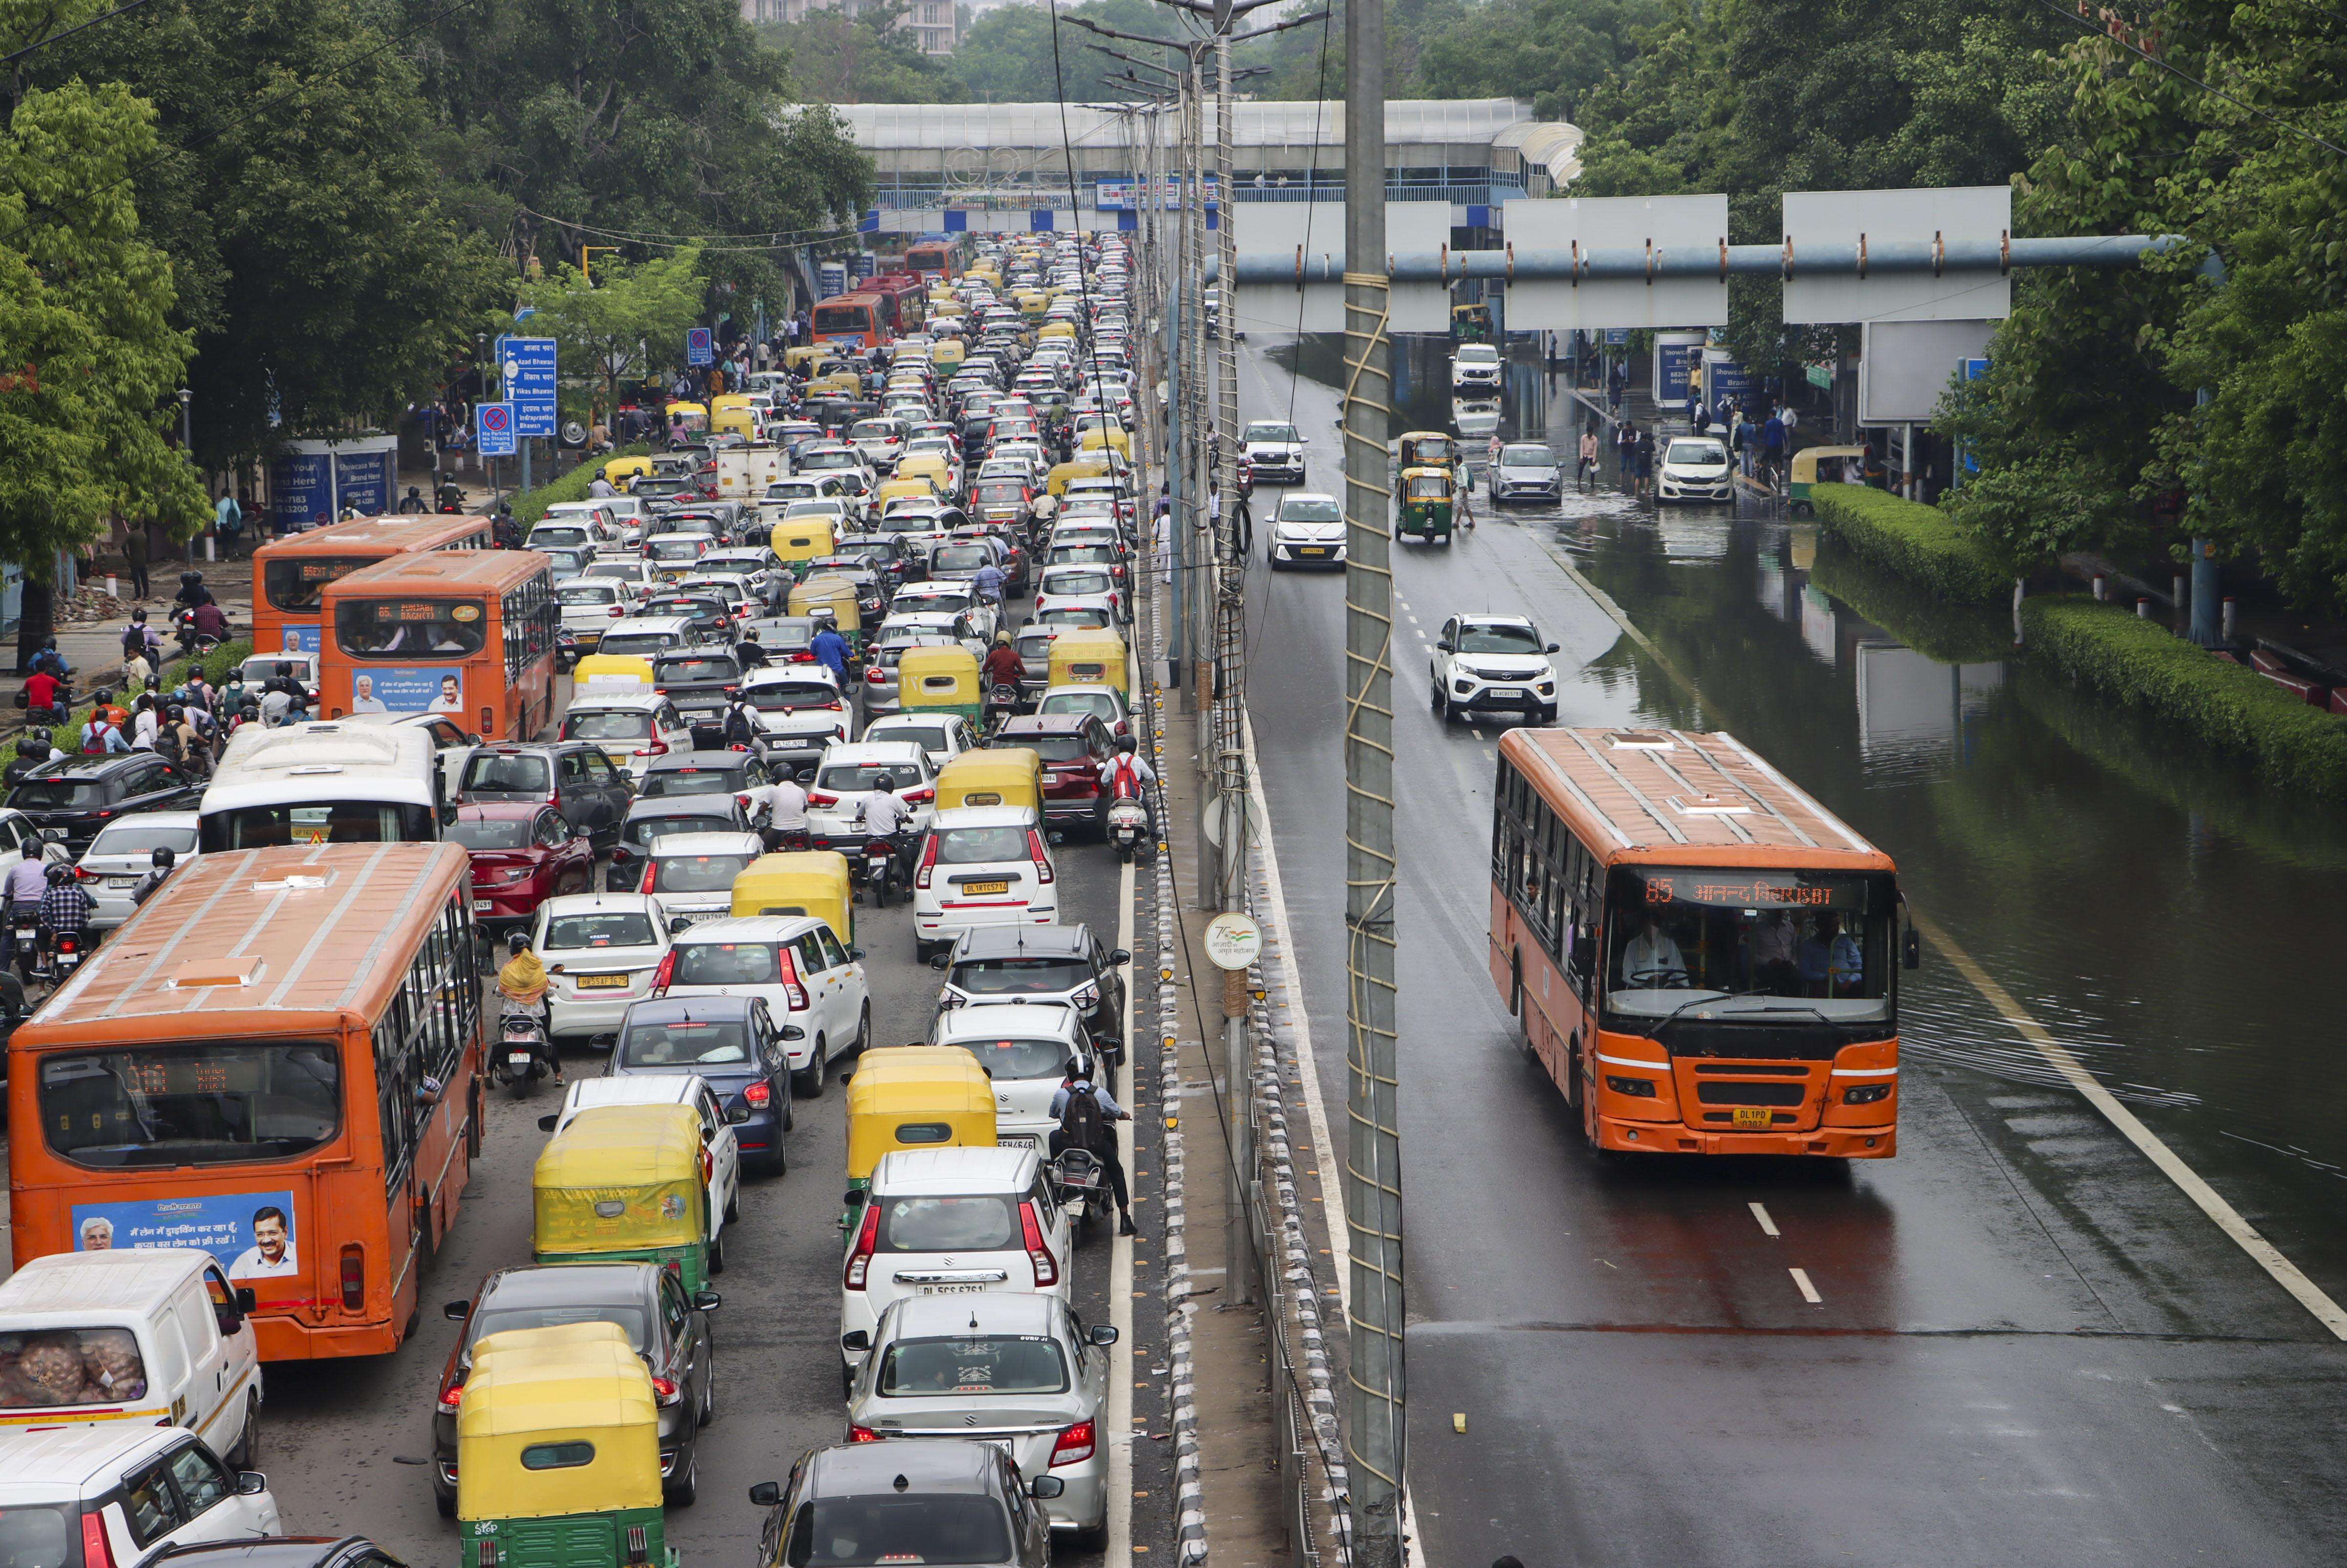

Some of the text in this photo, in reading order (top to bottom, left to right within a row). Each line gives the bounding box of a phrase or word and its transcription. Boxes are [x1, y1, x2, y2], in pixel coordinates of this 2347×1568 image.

[339, 464, 368, 472] Showcase
[967, 883, 1007, 892] DL1RTC5714
[1646, 878, 1673, 903] 85
[1217, 947, 1255, 956] अमृत महोत्सव
[1741, 1110, 1766, 1119] DL 1PD
[158, 1203, 180, 1212] दिल्ली
[140, 1227, 154, 1237] लेन
[156, 1226, 165, 1235] में
[166, 1223, 196, 1237] ड्राइविंग
[157, 1239, 170, 1248] बस
[172, 1236, 187, 1248] लेन
[189, 1237, 200, 1246] को
[201, 1236, 214, 1247] फ्री
[215, 1235, 230, 1244] रखें
